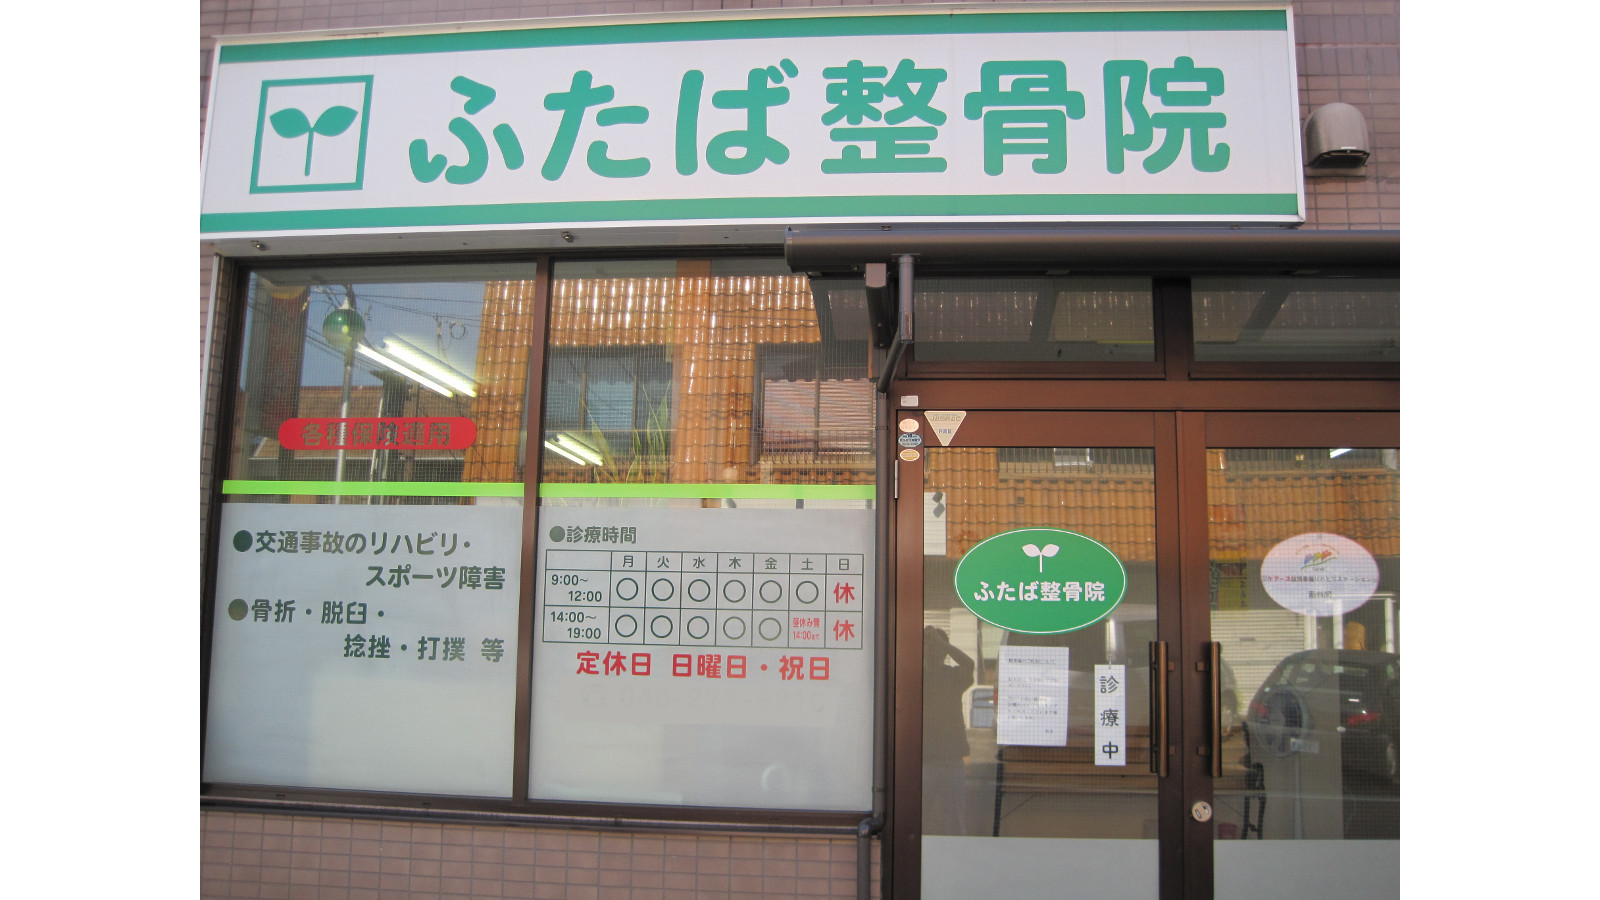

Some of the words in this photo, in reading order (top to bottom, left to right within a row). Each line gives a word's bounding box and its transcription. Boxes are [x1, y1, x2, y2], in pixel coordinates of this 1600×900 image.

[408, 55, 1231, 185] ふたば整骨院
[301, 421, 451, 446] 各種保険適用
[566, 525, 637, 544] 診療時間
[622, 555, 634, 568] 月
[657, 556, 670, 569] 火
[692, 556, 706, 569] 水
[728, 557, 742, 569] 木
[764, 557, 778, 570] 金
[800, 558, 814, 571] 土
[838, 558, 850, 571] 日
[365, 563, 506, 590] スポーツ障害
[568, 590, 603, 602] 12:00
[833, 582, 856, 604] 休
[974, 580, 1105, 602] ふたば整骨院
[567, 627, 602, 639] 19:00
[833, 619, 855, 642] 休
[481, 637, 505, 663] 等
[576, 650, 651, 676] 定休日
[672, 654, 831, 681] 日曜日・祝日
[1100, 675, 1120, 759] 診療中
